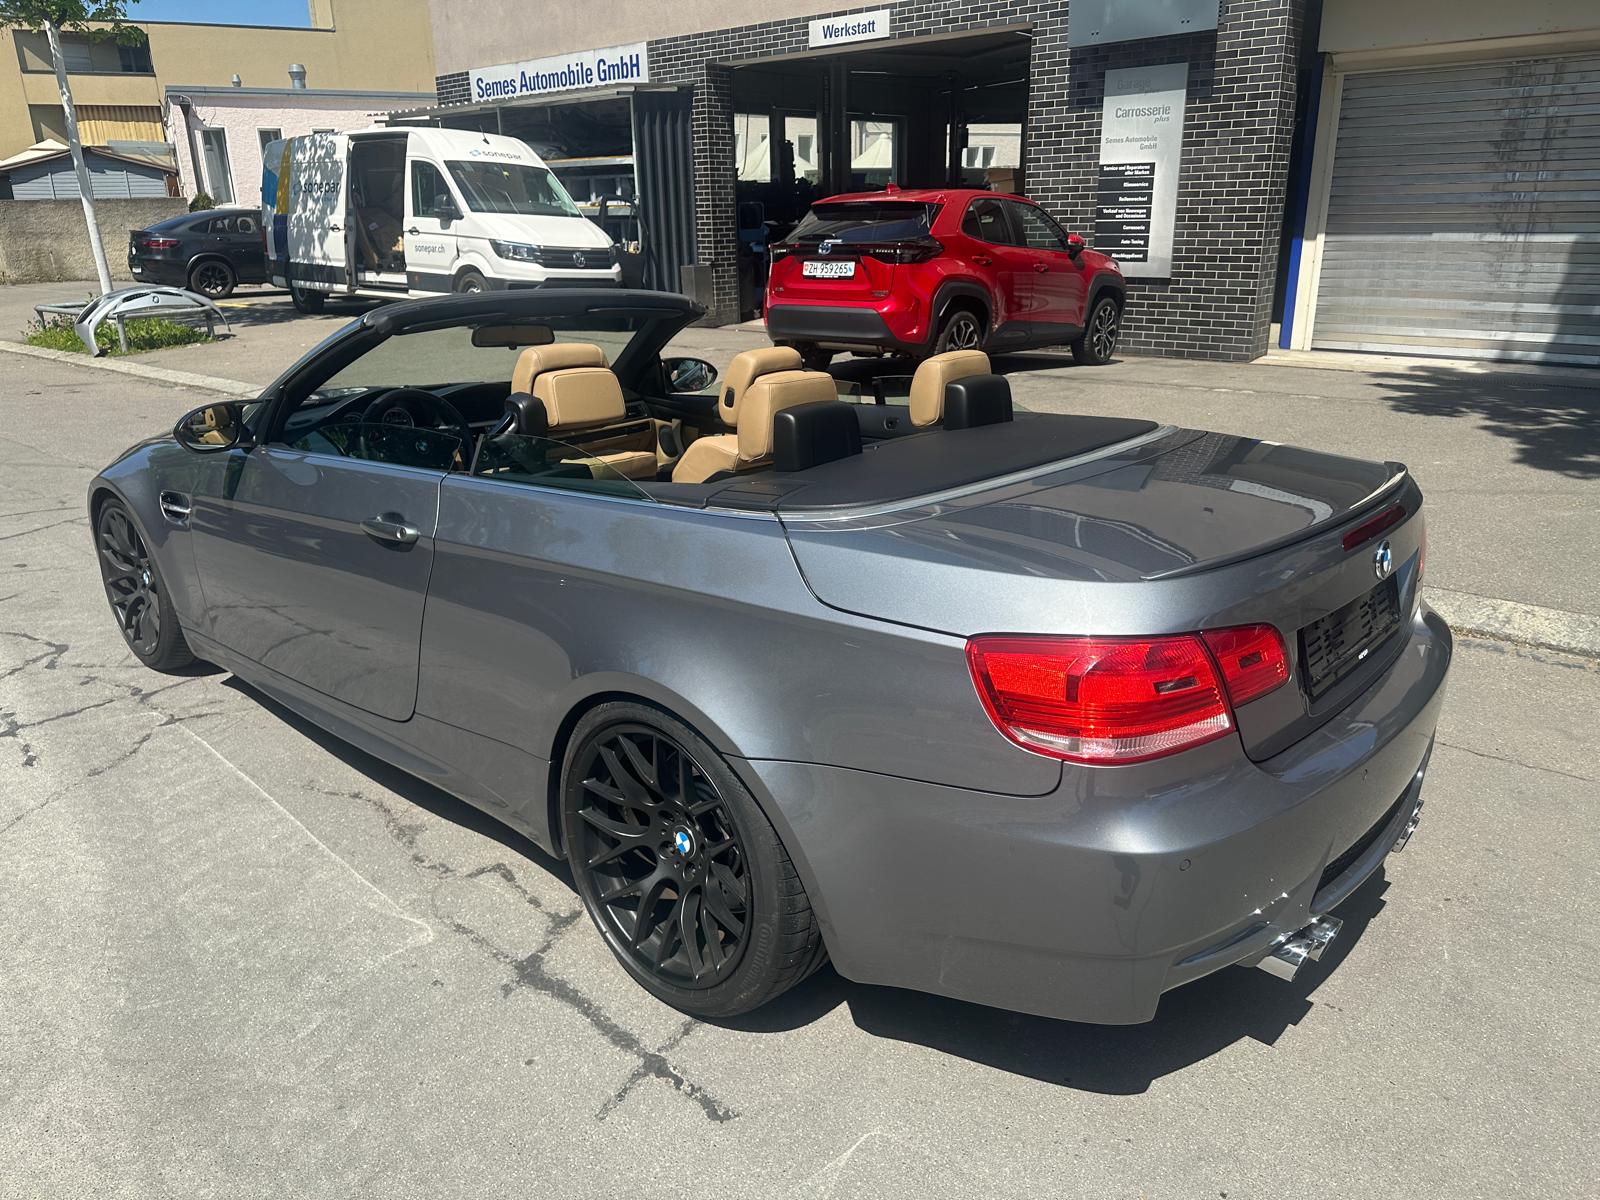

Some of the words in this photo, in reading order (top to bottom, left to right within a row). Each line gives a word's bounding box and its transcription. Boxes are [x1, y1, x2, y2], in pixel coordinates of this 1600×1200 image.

[822, 19, 876, 39] Werkstatt
[476, 77, 517, 99] Semes
[519, 62, 594, 93] Automobile
[597, 53, 641, 82] GmbH
[1115, 105, 1171, 119] Carrosserie
[1153, 115, 1170, 124] plus
[1125, 135, 1158, 143] Automobile
[482, 150, 521, 160] sonepar
[303, 180, 340, 196] sonepar
[414, 244, 446, 254] sonepar.ch
[808, 263, 818, 274] ZH
